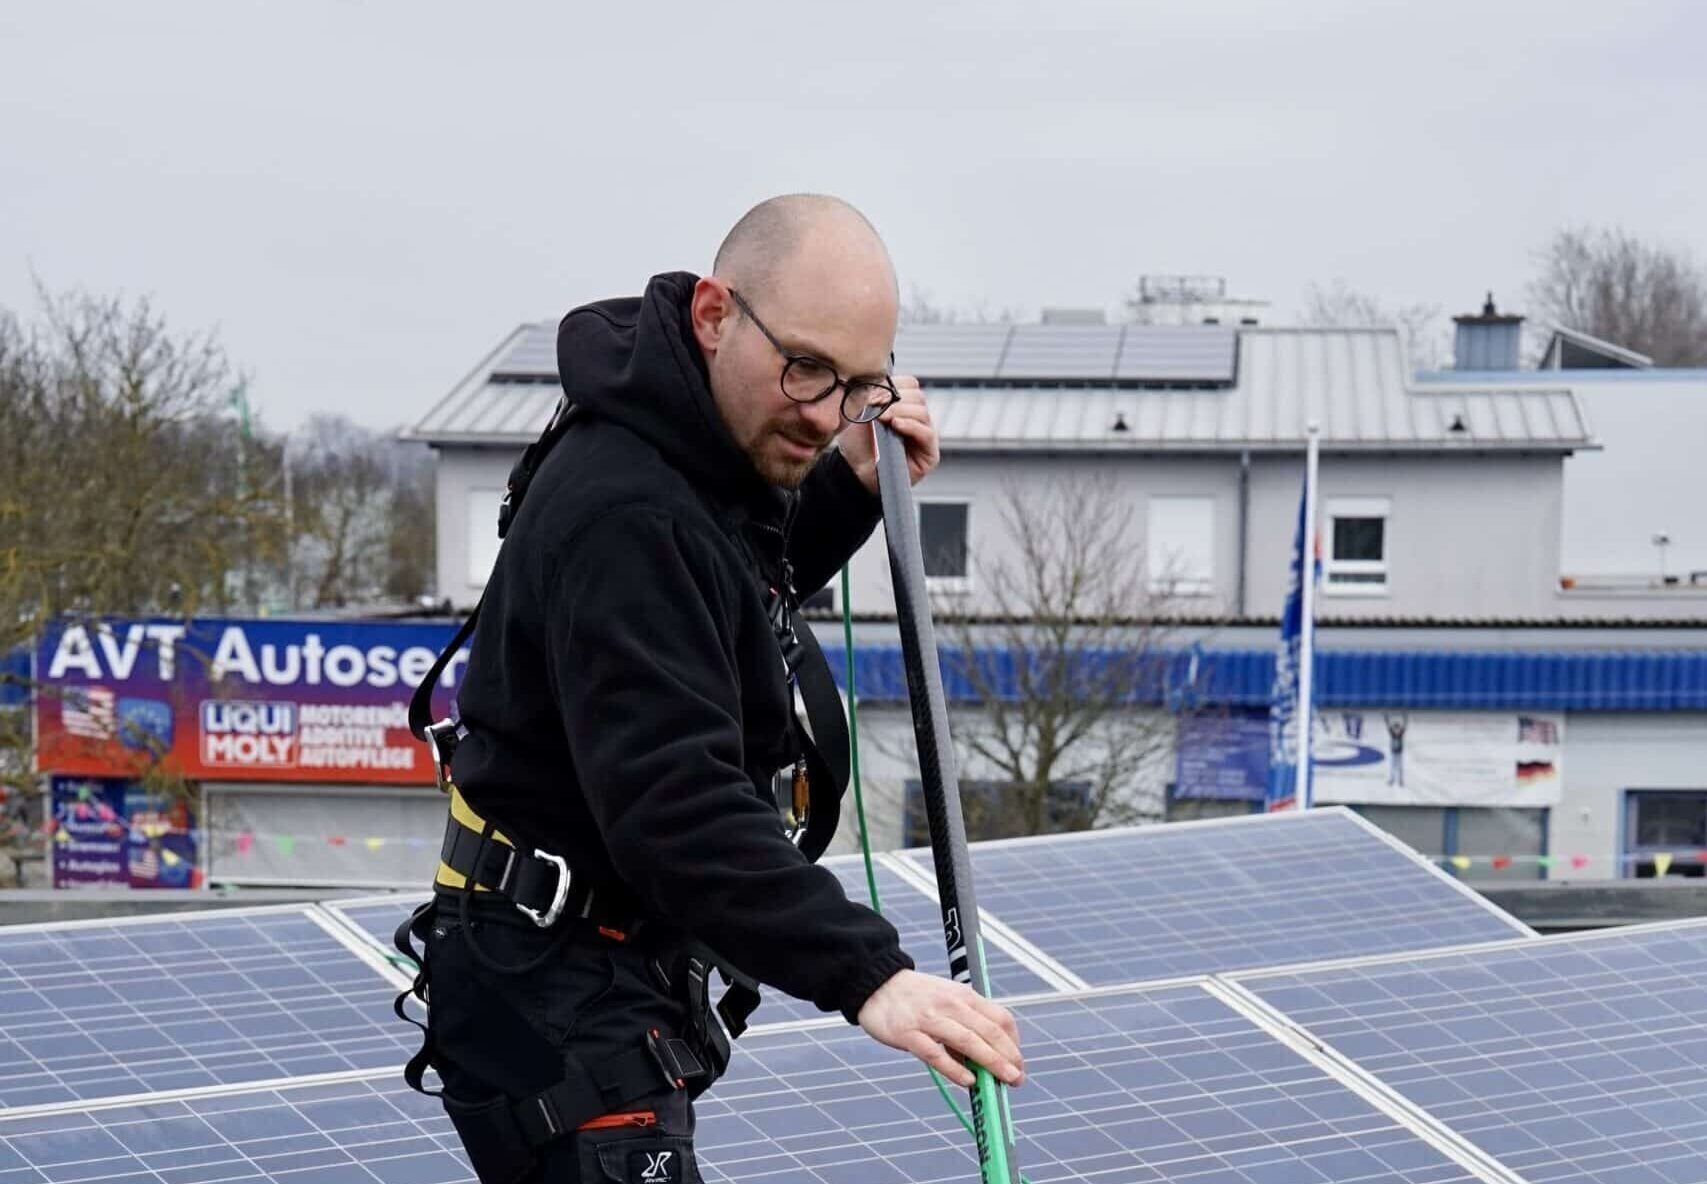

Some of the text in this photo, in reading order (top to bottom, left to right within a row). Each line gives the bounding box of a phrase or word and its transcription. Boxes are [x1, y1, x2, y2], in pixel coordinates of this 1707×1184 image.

[48, 624, 185, 681] AVT
[207, 702, 291, 732] LIQUI
[207, 733, 292, 763] MOLY
